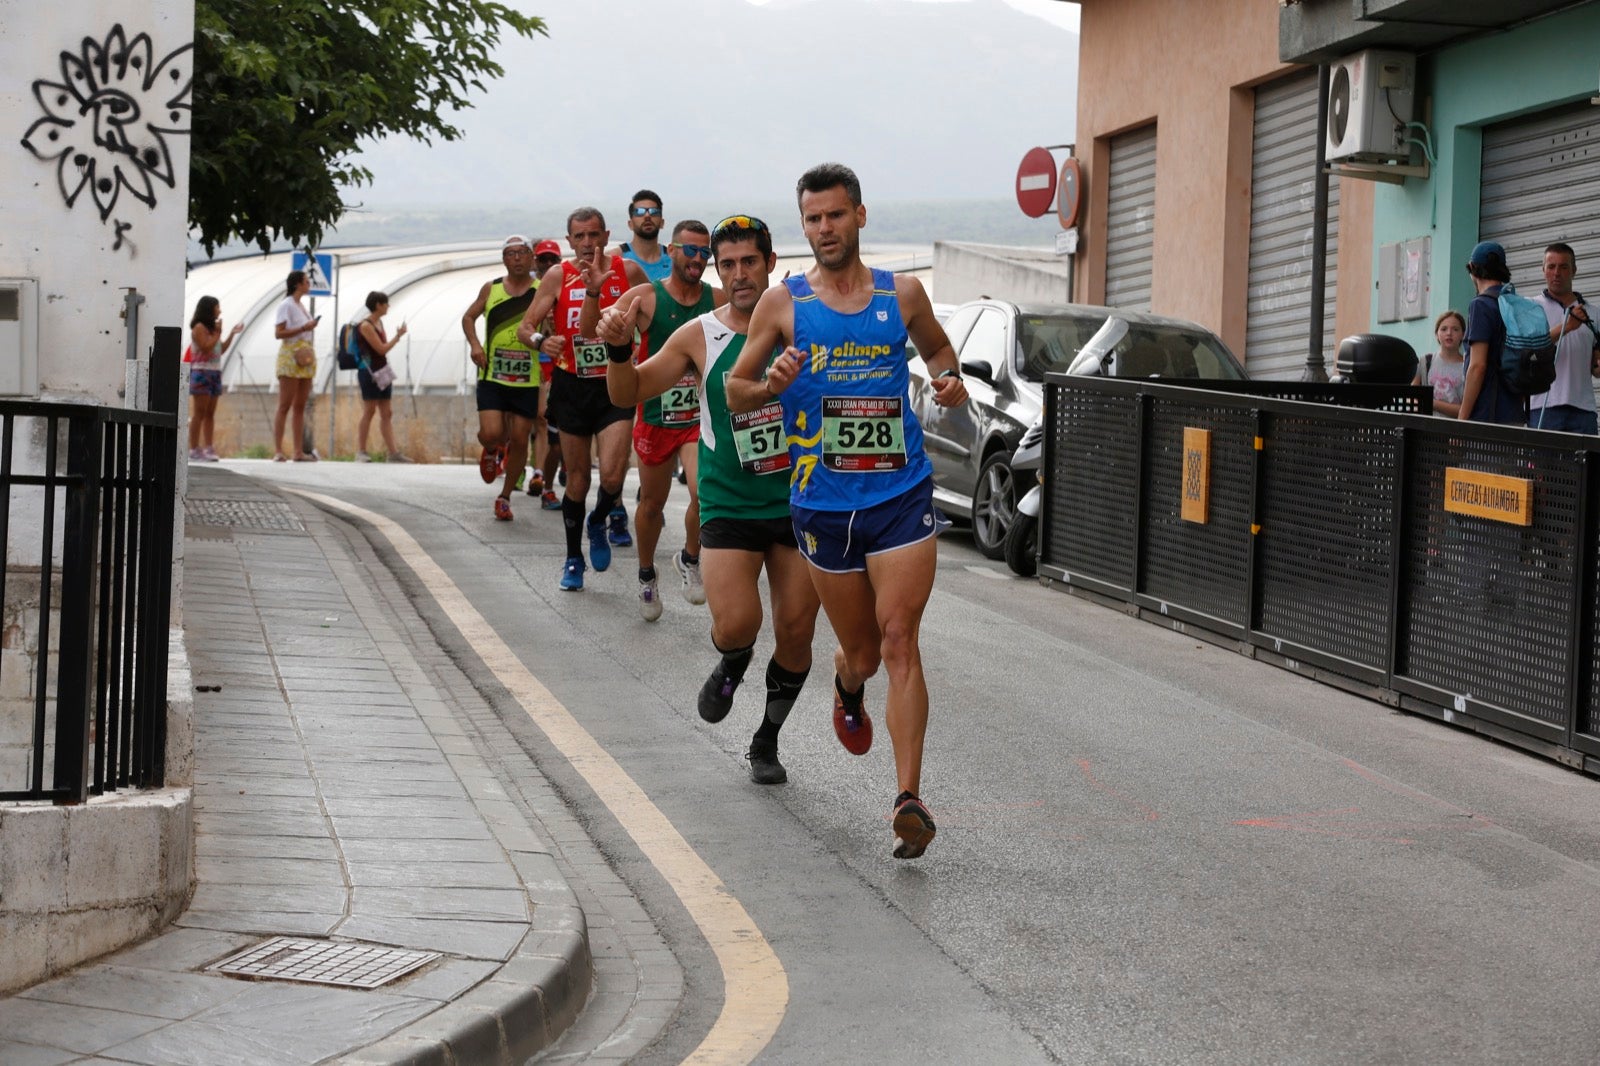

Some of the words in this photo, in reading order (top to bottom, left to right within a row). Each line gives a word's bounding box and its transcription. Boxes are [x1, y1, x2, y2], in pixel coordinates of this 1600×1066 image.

[833, 341, 890, 359] olimpo
[496, 360, 531, 373] 1145
[831, 359, 869, 368] deportes
[827, 373, 848, 382] TRAIL
[851, 373, 858, 381] &
[859, 369, 893, 380] RUNNING
[842, 400, 857, 409] GRAN
[858, 400, 877, 409] PREMIO
[878, 400, 885, 409] DE
[750, 424, 782, 454] 57
[837, 421, 893, 448] 528
[1450, 480, 1482, 505] CERVEZAS
[1483, 486, 1520, 514] ALHAMBRA
